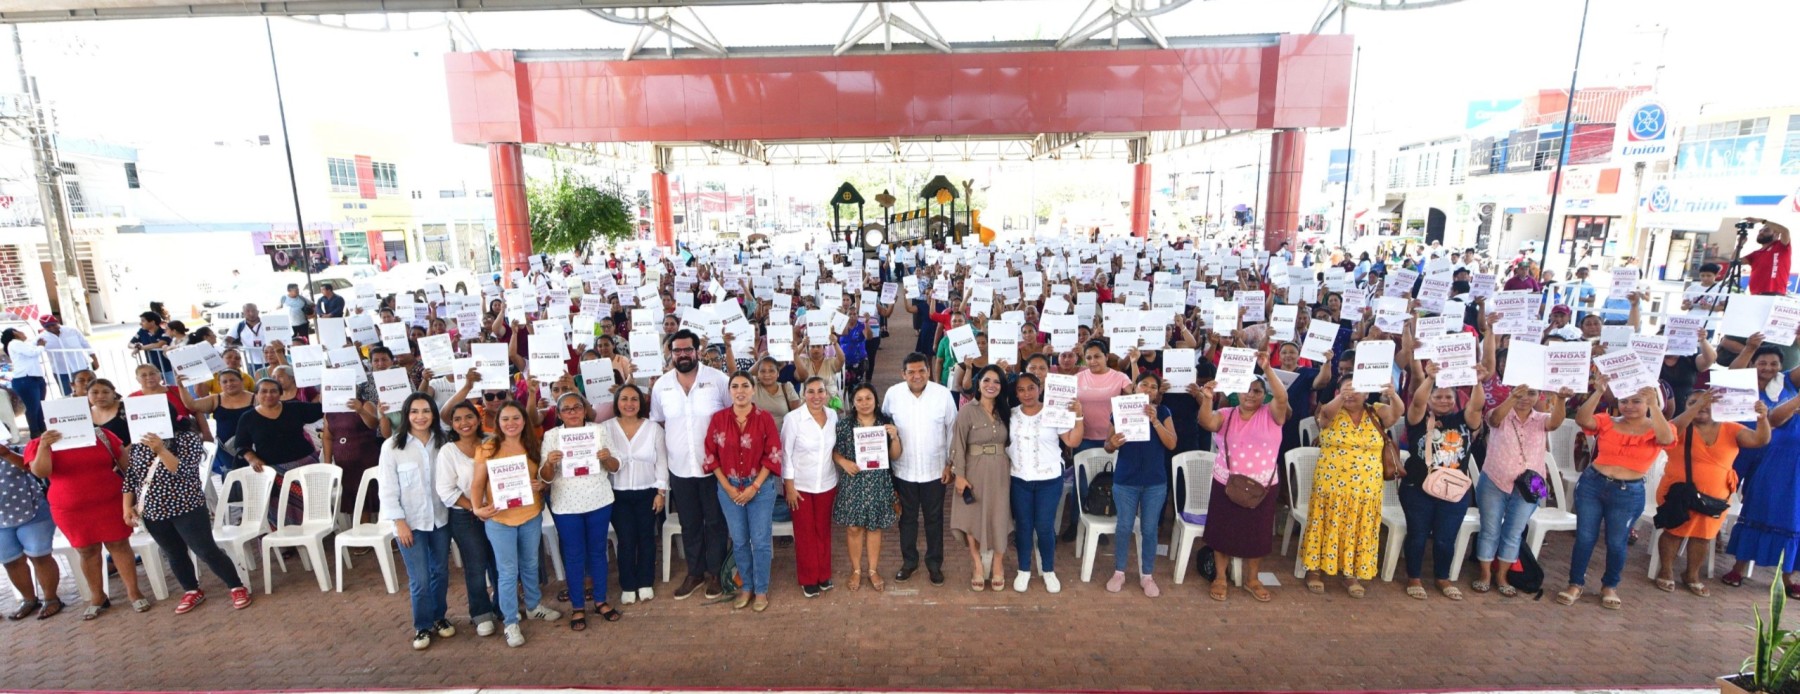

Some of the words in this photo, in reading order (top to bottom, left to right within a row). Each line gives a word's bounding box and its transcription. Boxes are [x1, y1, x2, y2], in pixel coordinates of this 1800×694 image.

[1622, 144, 1665, 156] Unión
[1601, 355, 1637, 366] TANDAS
[492, 465, 525, 474] TANDAS
